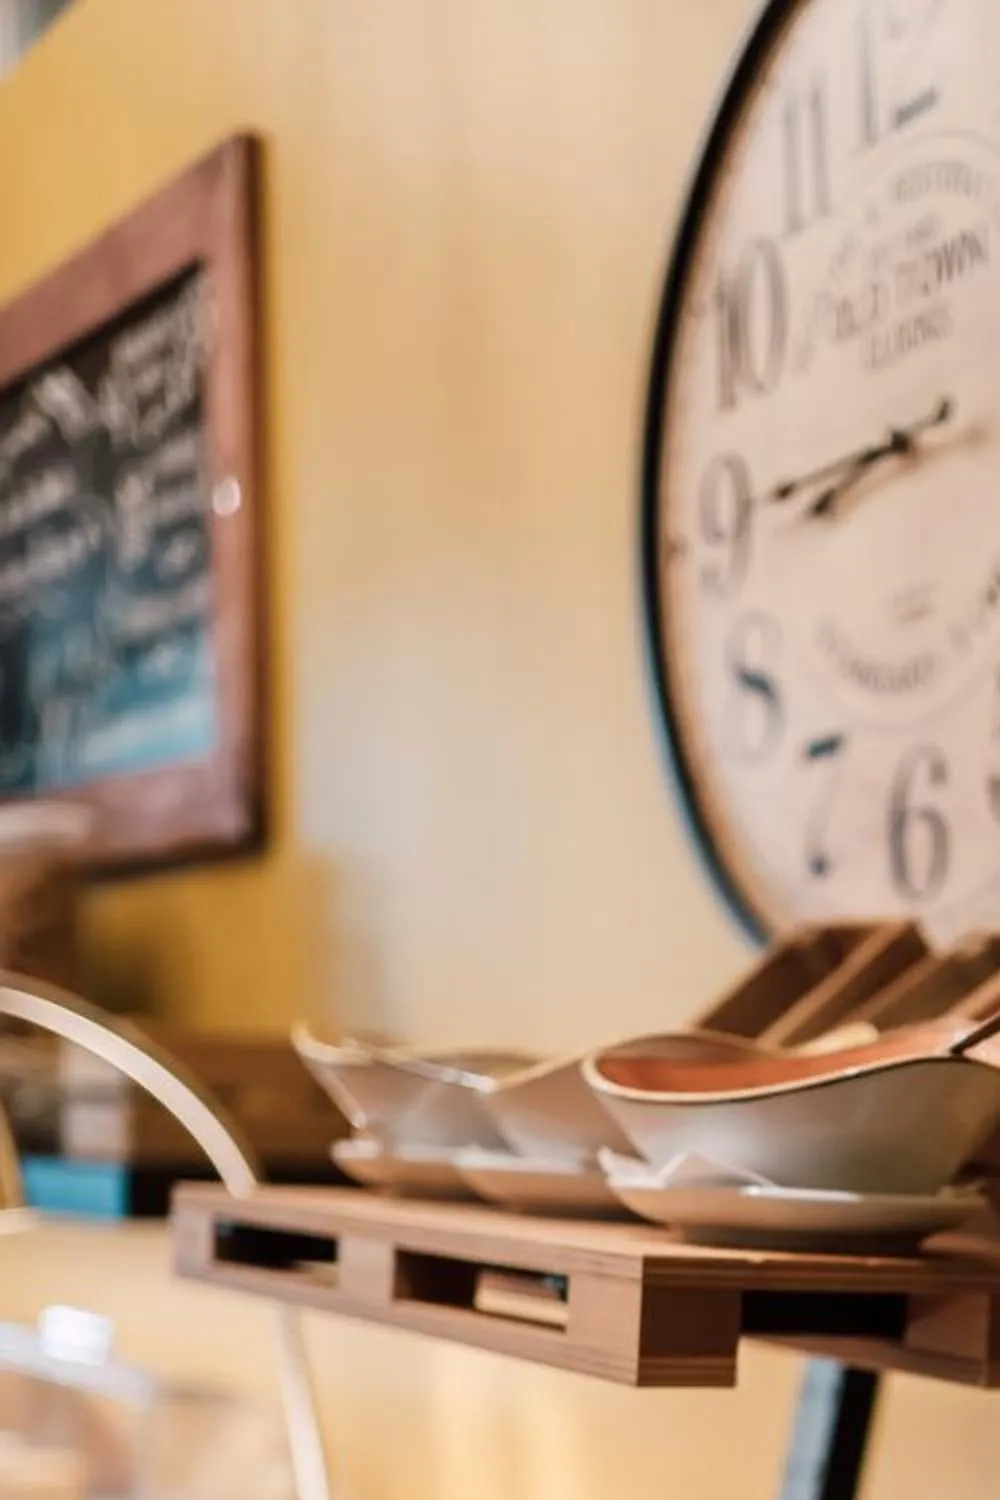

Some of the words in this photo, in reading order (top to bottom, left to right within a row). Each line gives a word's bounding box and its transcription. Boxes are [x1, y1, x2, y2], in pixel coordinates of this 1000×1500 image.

[780, 70, 833, 236] 11
[710, 238, 785, 410] 10
[701, 453, 751, 595] 9
[723, 610, 783, 765] 8
[794, 725, 854, 881] 7
[885, 740, 953, 904] 6
